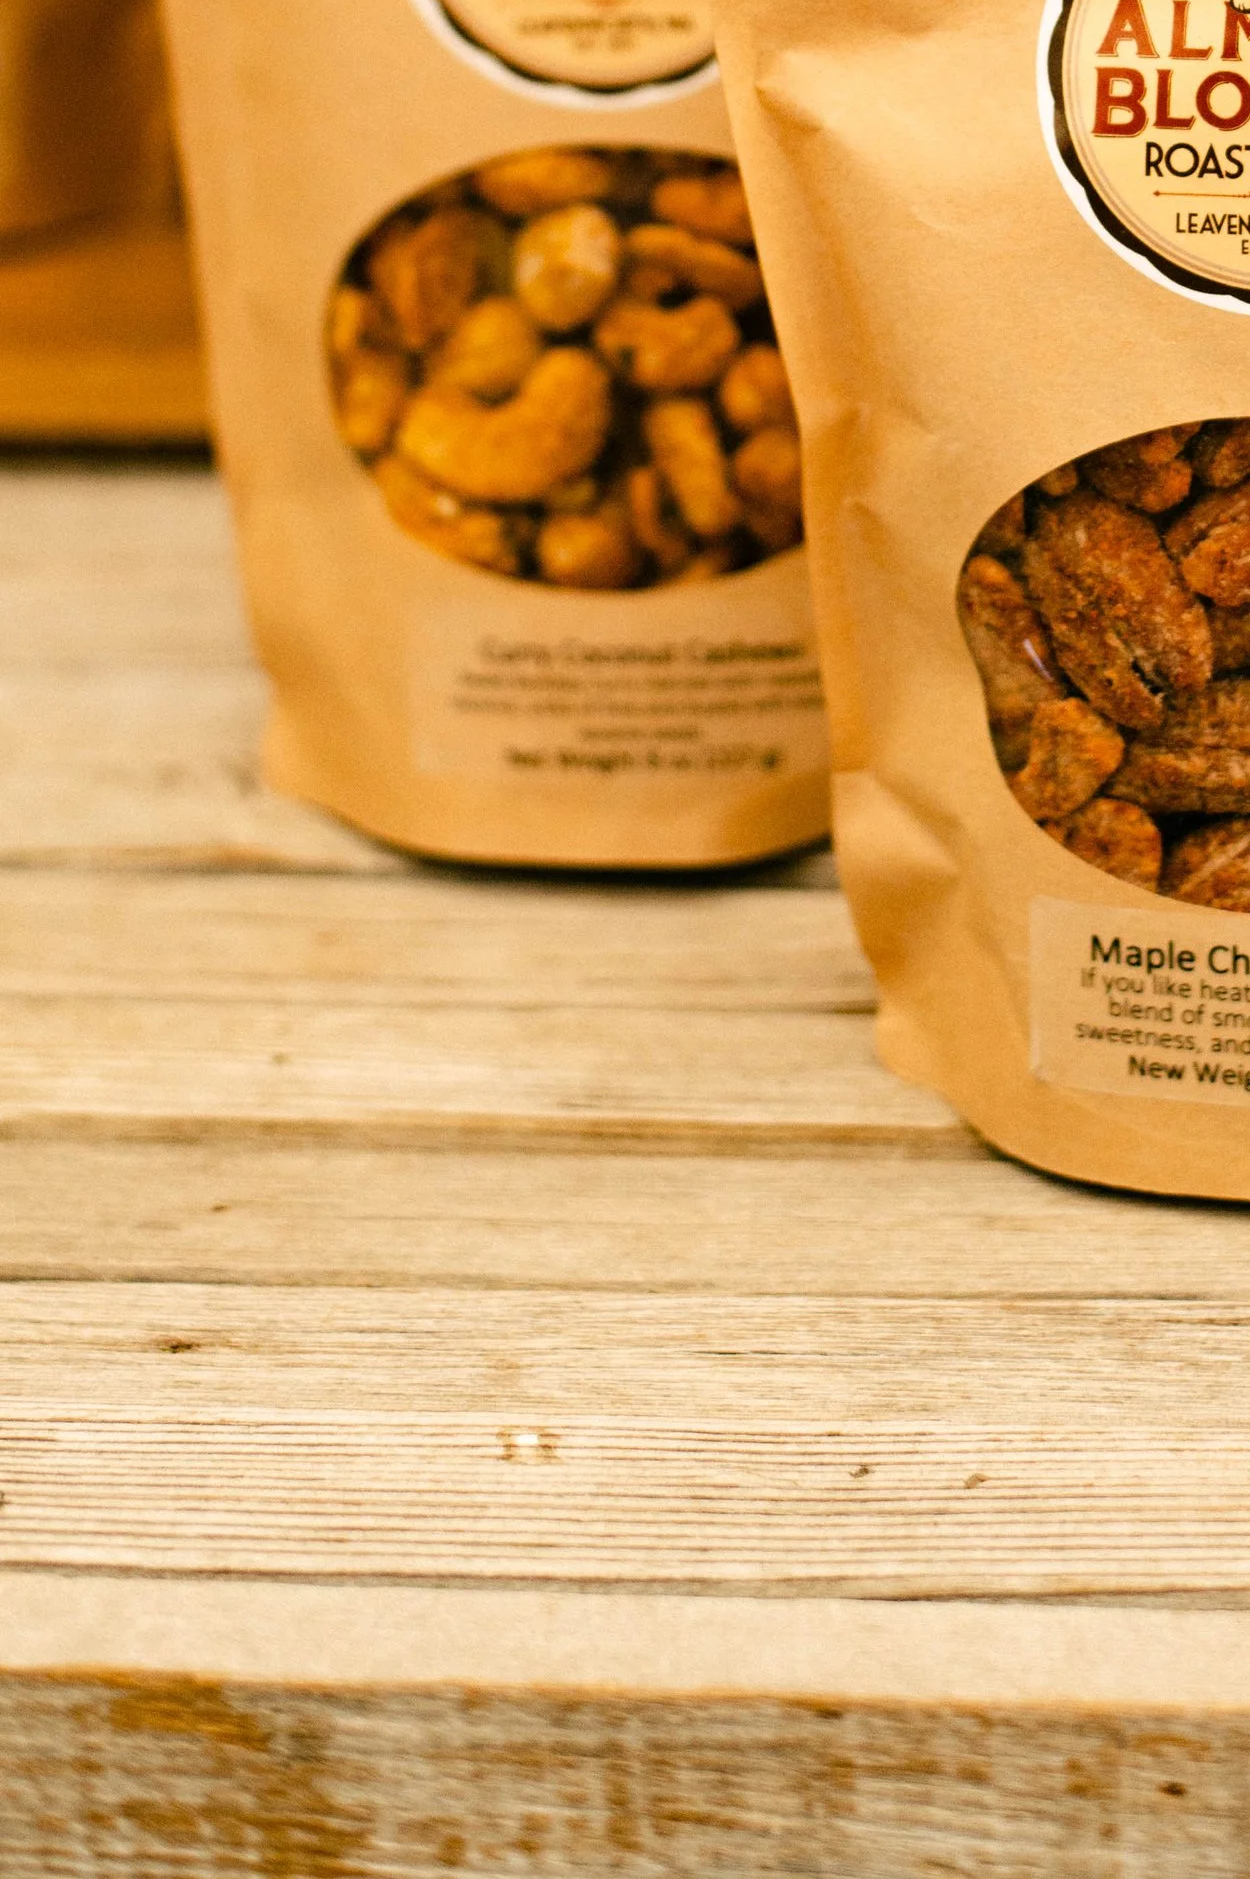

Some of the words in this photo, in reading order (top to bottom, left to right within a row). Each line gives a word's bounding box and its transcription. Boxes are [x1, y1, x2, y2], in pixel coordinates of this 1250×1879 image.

[1091, 934, 1196, 976] Maple
[1080, 967, 1097, 988] If
[1102, 975, 1145, 994] you
[1152, 973, 1193, 999] like
[1107, 995, 1174, 1023] blend
[1180, 1003, 1206, 1025] of
[1075, 1022, 1202, 1054] sweetness,
[1127, 1053, 1186, 1081] New
